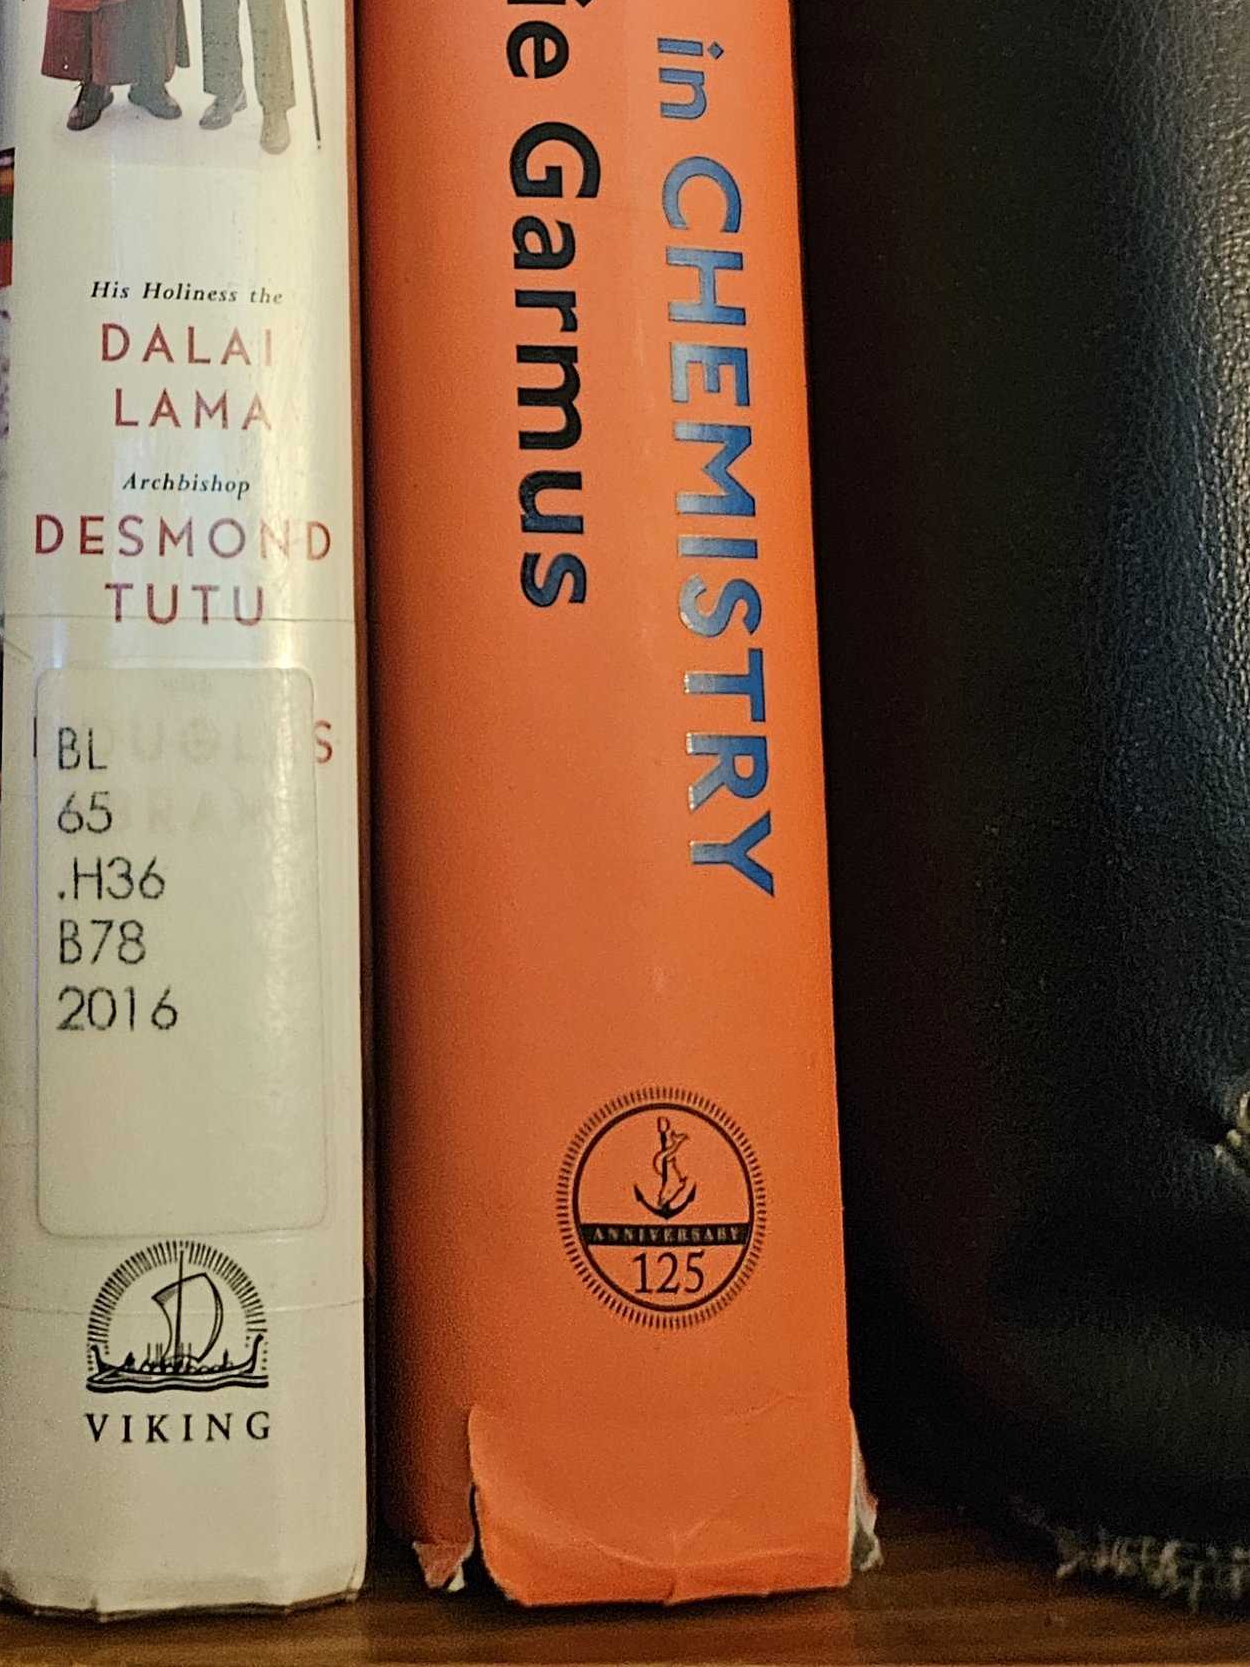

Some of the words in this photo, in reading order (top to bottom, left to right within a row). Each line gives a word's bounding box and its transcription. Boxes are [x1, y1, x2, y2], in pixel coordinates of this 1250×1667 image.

[658, 38, 724, 121] in
[90, 281, 130, 299] His
[142, 282, 238, 303] Holiness
[250, 287, 284, 305] the
[101, 322, 272, 367] DALAI
[510, 121, 601, 608] Garmus
[115, 387, 272, 431] LAMA
[122, 472, 252, 500] Archbishop
[35, 512, 333, 563] DESMOND
[664, 156, 775, 896] CHEMISTRY
[105, 581, 266, 626] TUTU
[57, 726, 108, 771] BL
[57, 790, 113, 834] 65
[56, 855, 166, 901] .H36
[58, 918, 146, 966] B78
[56, 985, 179, 1032] 2016
[592, 1225, 740, 1243] ANNIVERSARY
[633, 1249, 706, 1295] 125
[85, 1410, 271, 1443] VIKING
